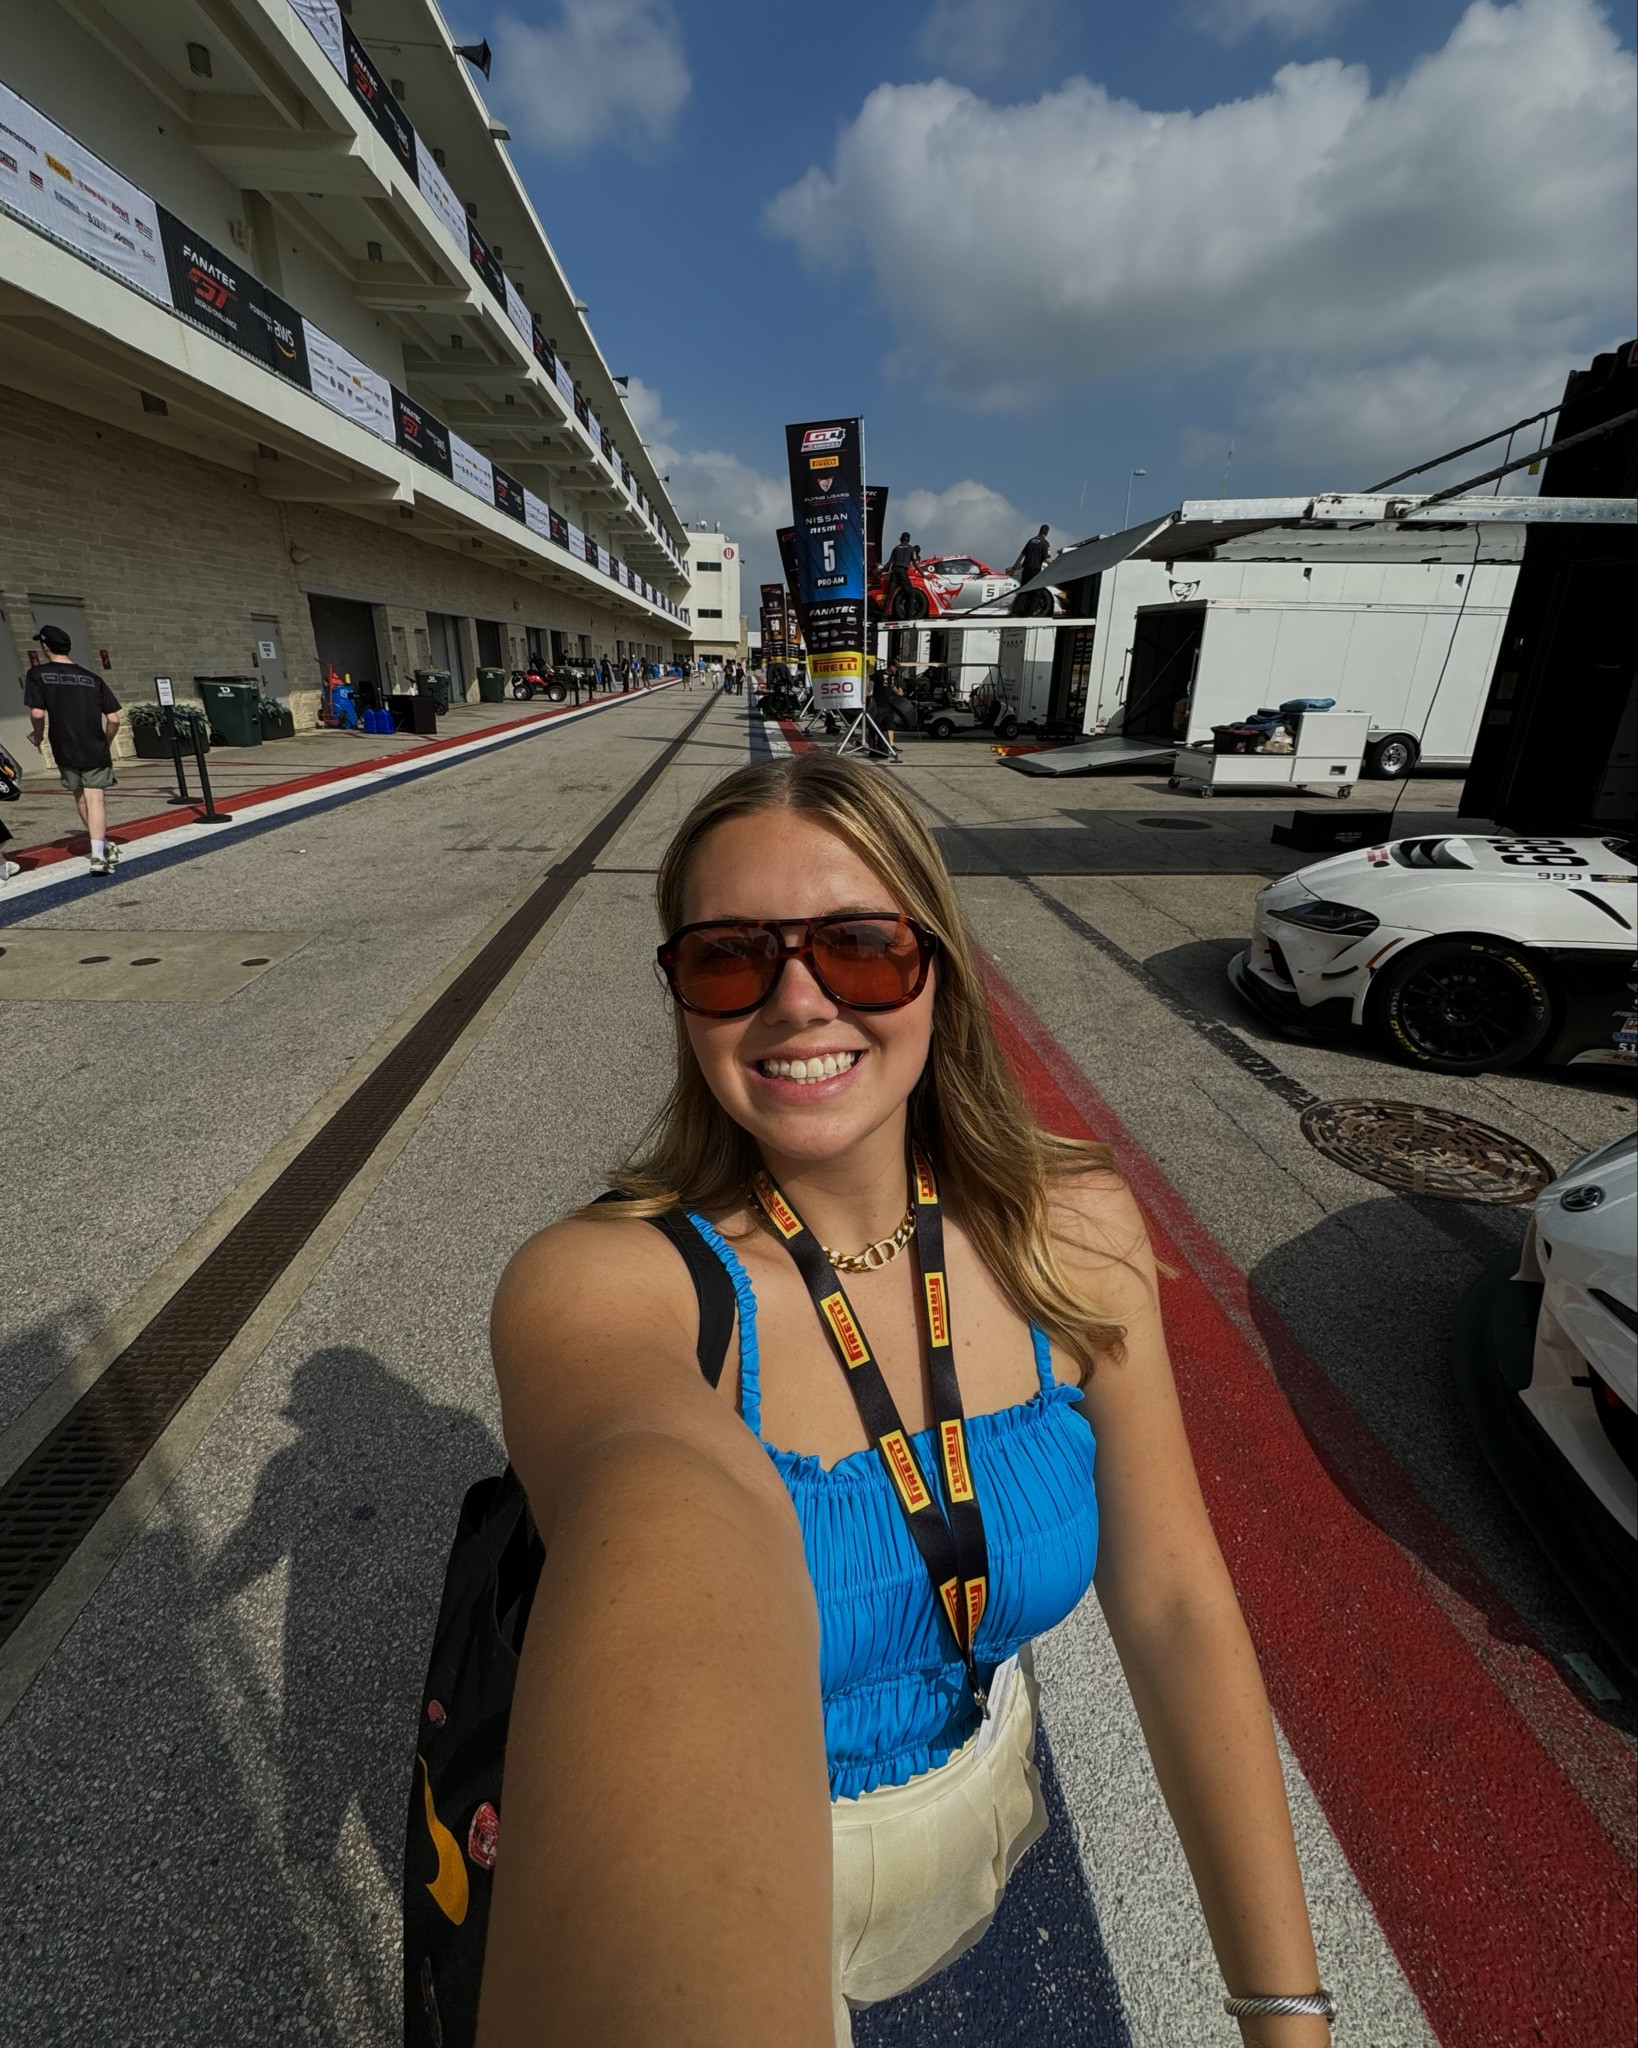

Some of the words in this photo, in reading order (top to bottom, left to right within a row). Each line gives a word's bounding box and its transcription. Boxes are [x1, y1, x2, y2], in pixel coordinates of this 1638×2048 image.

[183, 245, 237, 292] FANATEC
[249, 302, 272, 323] POWERED
[273, 320, 295, 347] aws
[812, 458, 837, 468] PIRELLI
[805, 513, 848, 525] NISSAN
[810, 523, 845, 535] nismo
[823, 540, 836, 572] 5
[817, 577, 845, 587] PRO-AM
[986, 588, 995, 597] 5
[809, 606, 857, 617] FANATEC
[812, 657, 858, 673] PIRELLI
[820, 682, 854, 695] SRO
[1538, 872, 1582, 881] 999
[1504, 956, 1543, 1001] PIRELLI
[928, 1278, 946, 1341] PIRELLI
[828, 1299, 864, 1362] PIRELLI
[945, 1425, 969, 1495] PIRELLI
[887, 1437, 925, 1506] PIRELLI
